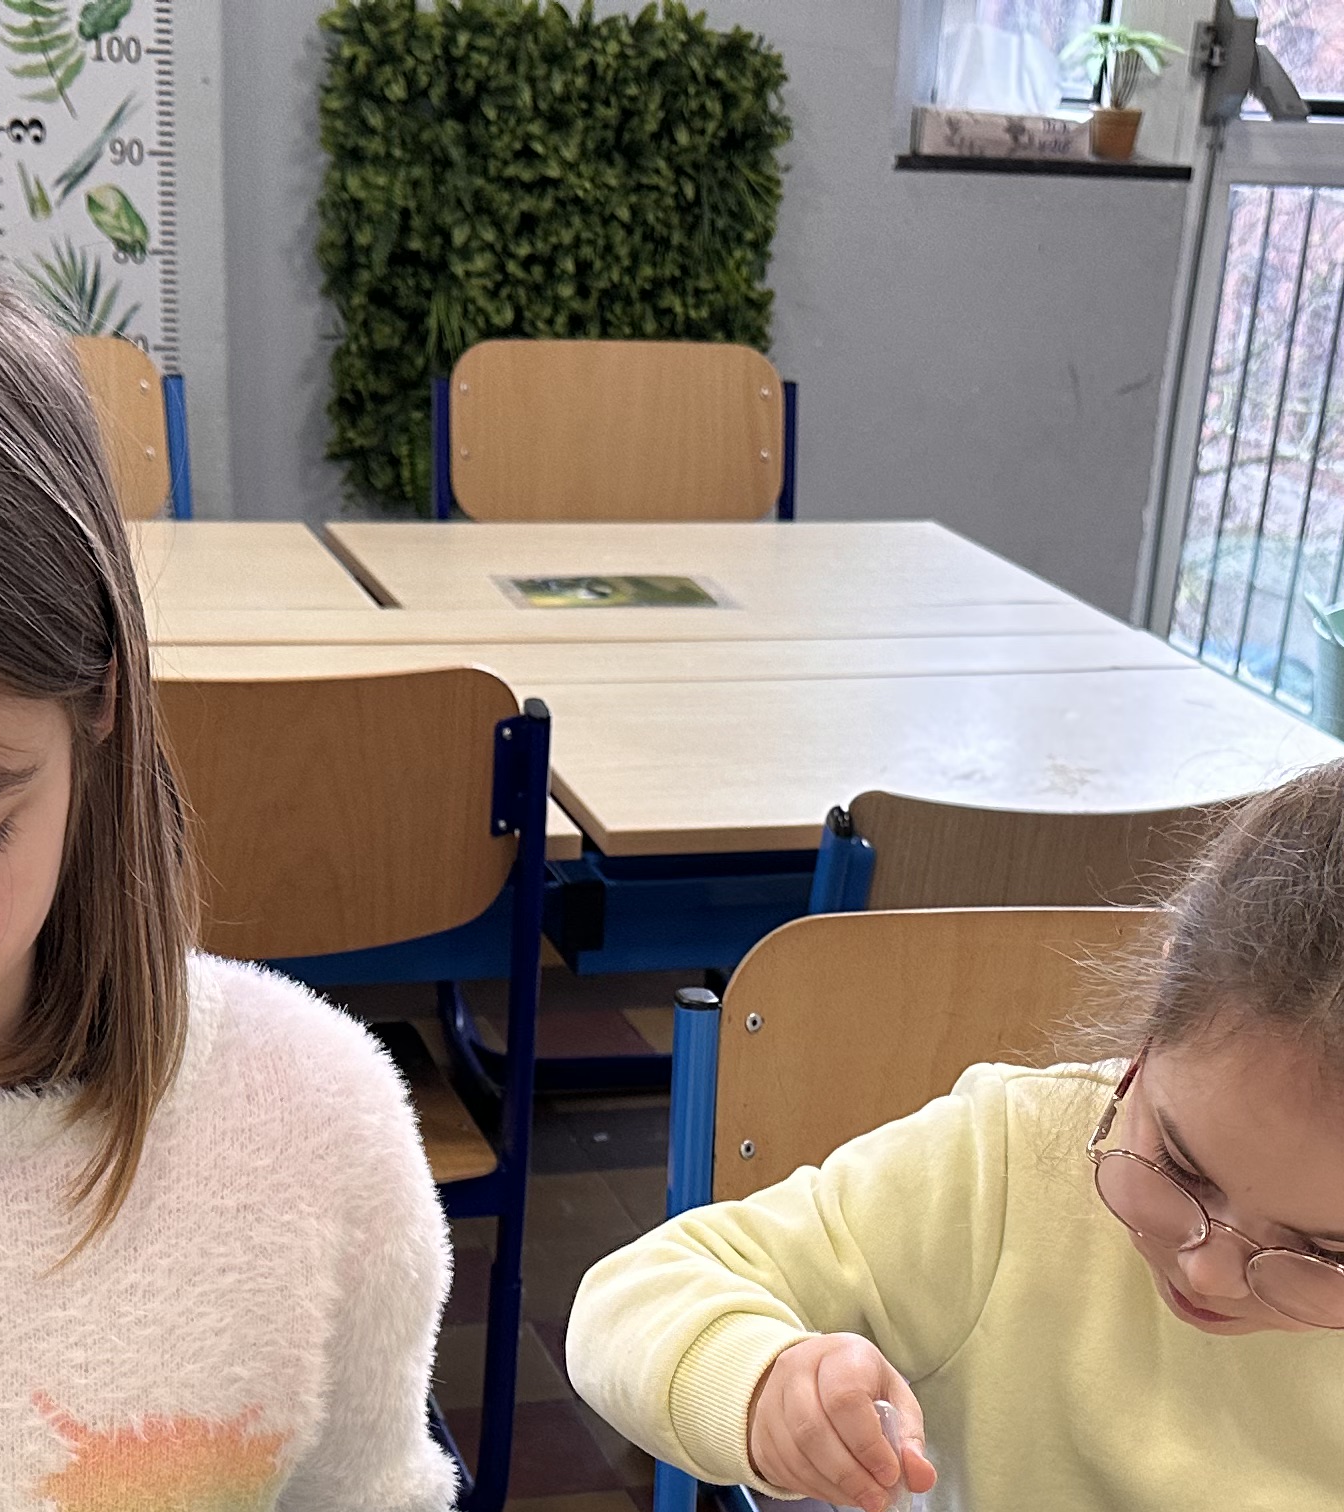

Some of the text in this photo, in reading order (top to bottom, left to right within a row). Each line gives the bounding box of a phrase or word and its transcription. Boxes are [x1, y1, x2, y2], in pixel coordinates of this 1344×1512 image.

[90, 35, 143, 64] 100
[6, 117, 47, 145] 3
[109, 136, 145, 167] 90
